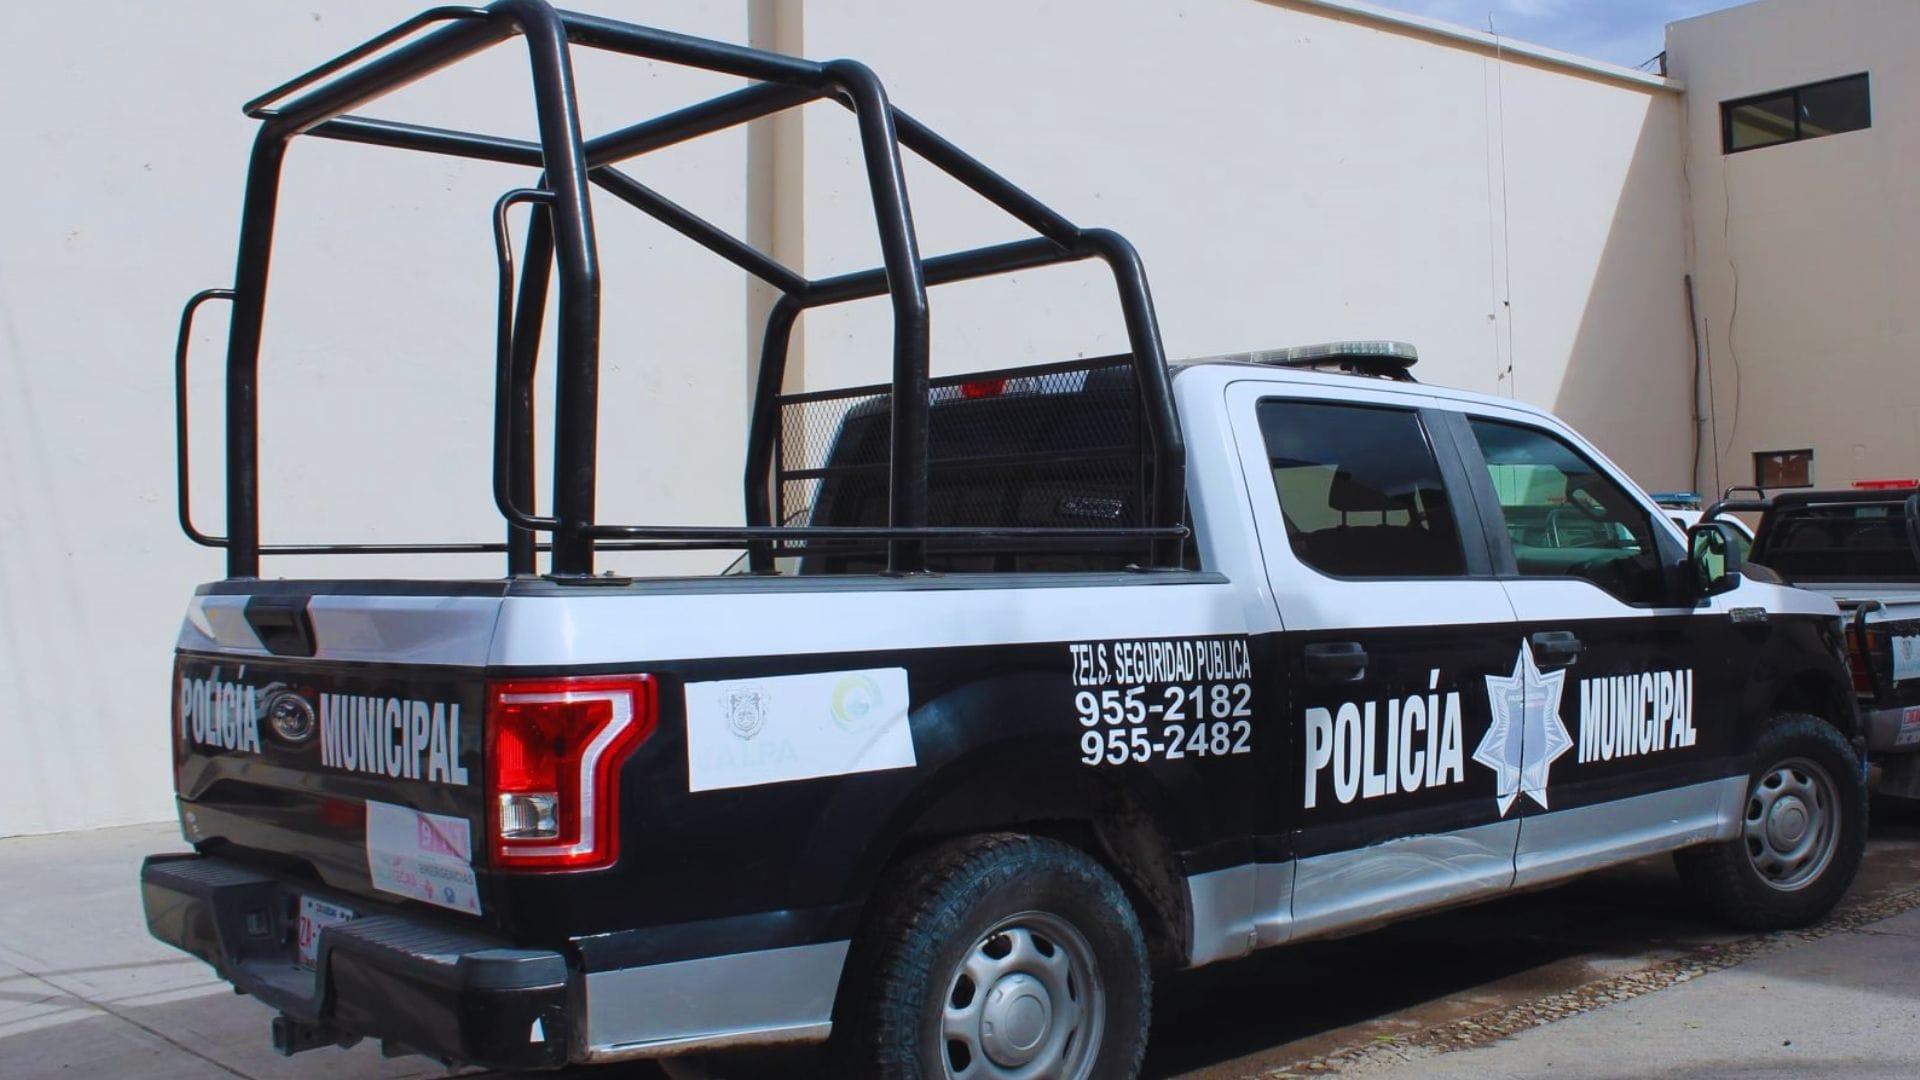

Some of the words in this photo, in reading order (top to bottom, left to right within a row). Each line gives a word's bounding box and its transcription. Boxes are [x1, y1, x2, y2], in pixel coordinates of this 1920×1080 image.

[1114, 641, 1194, 684] SEGURIDAD
[1195, 639, 1252, 681] PUBLICA
[182, 664, 261, 754] POLICÍA
[320, 692, 469, 786] MUNICIPAL
[1075, 683, 1252, 727] 955-2182
[1080, 720, 1251, 766] 955-2482
[1304, 668, 1465, 809] POLICÍA
[1578, 668, 1697, 764] MUNICIPAL
